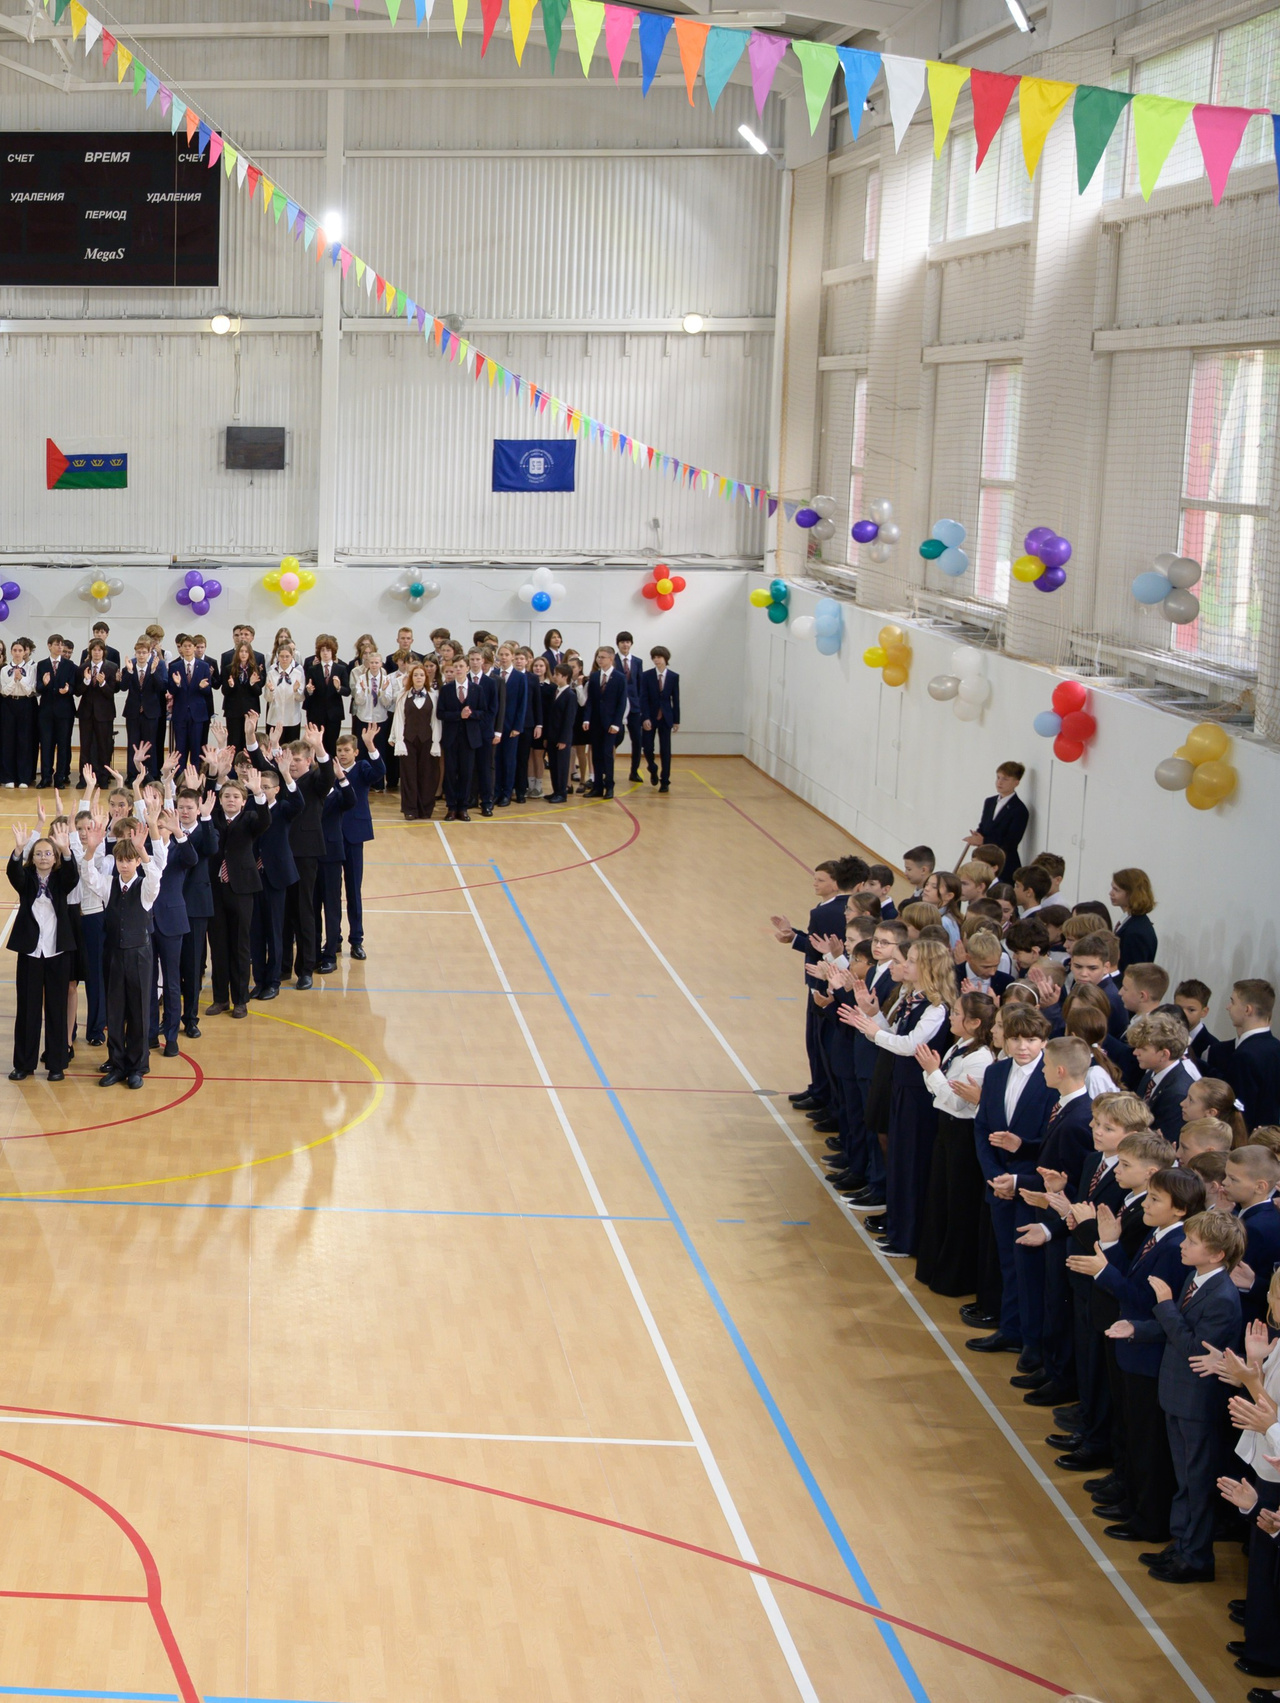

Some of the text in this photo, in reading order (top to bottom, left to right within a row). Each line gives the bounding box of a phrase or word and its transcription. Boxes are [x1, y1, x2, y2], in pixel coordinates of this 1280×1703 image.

[7, 154, 34, 163] СЧЕТ
[84, 151, 130, 163] ВРЕМЯ
[178, 154, 205, 163] СЧЕТ
[10, 192, 64, 202] УДАЛЕНИЯ
[146, 192, 201, 203] УДАЛЕНИЯ
[84, 210, 126, 221] ПЕРИОД
[83, 247, 125, 262] MegaS
